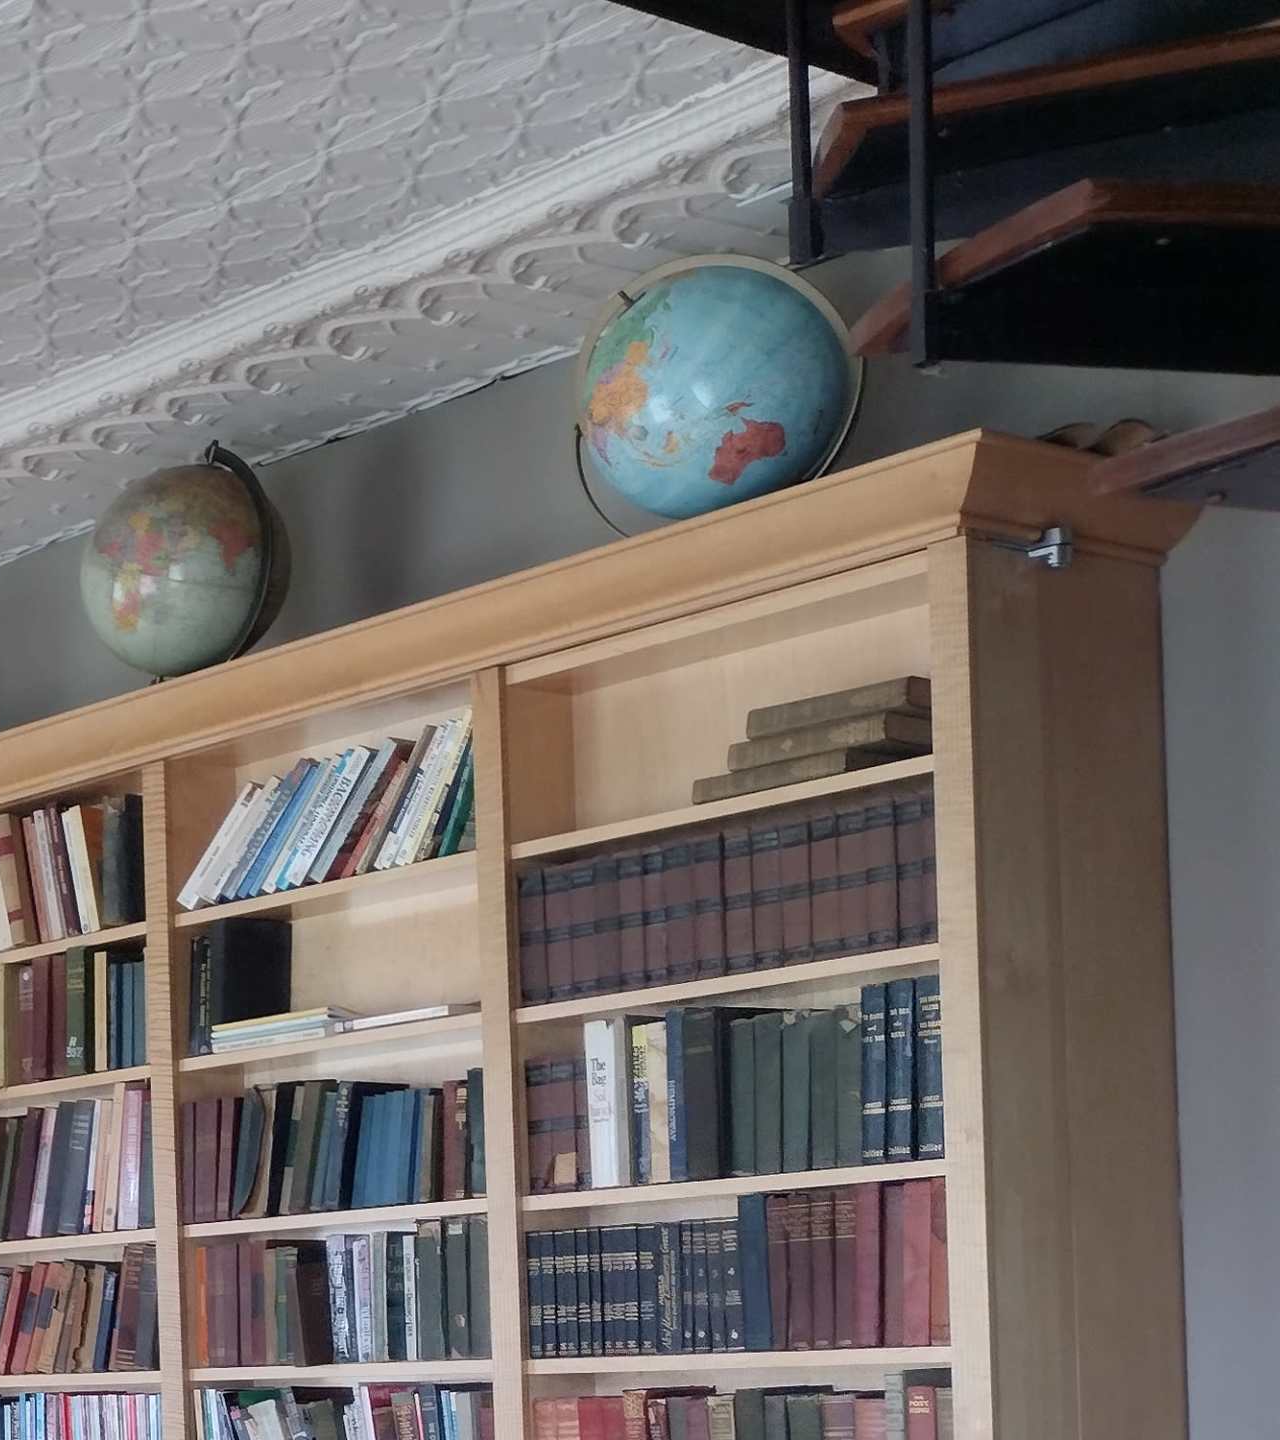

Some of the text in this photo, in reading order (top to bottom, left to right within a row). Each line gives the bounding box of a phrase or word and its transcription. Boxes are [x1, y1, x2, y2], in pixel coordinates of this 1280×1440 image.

[590, 1056, 606, 1071] The
[667, 1079, 676, 1141] HEMINGWAY
[727, 1266, 735, 1275] 4
